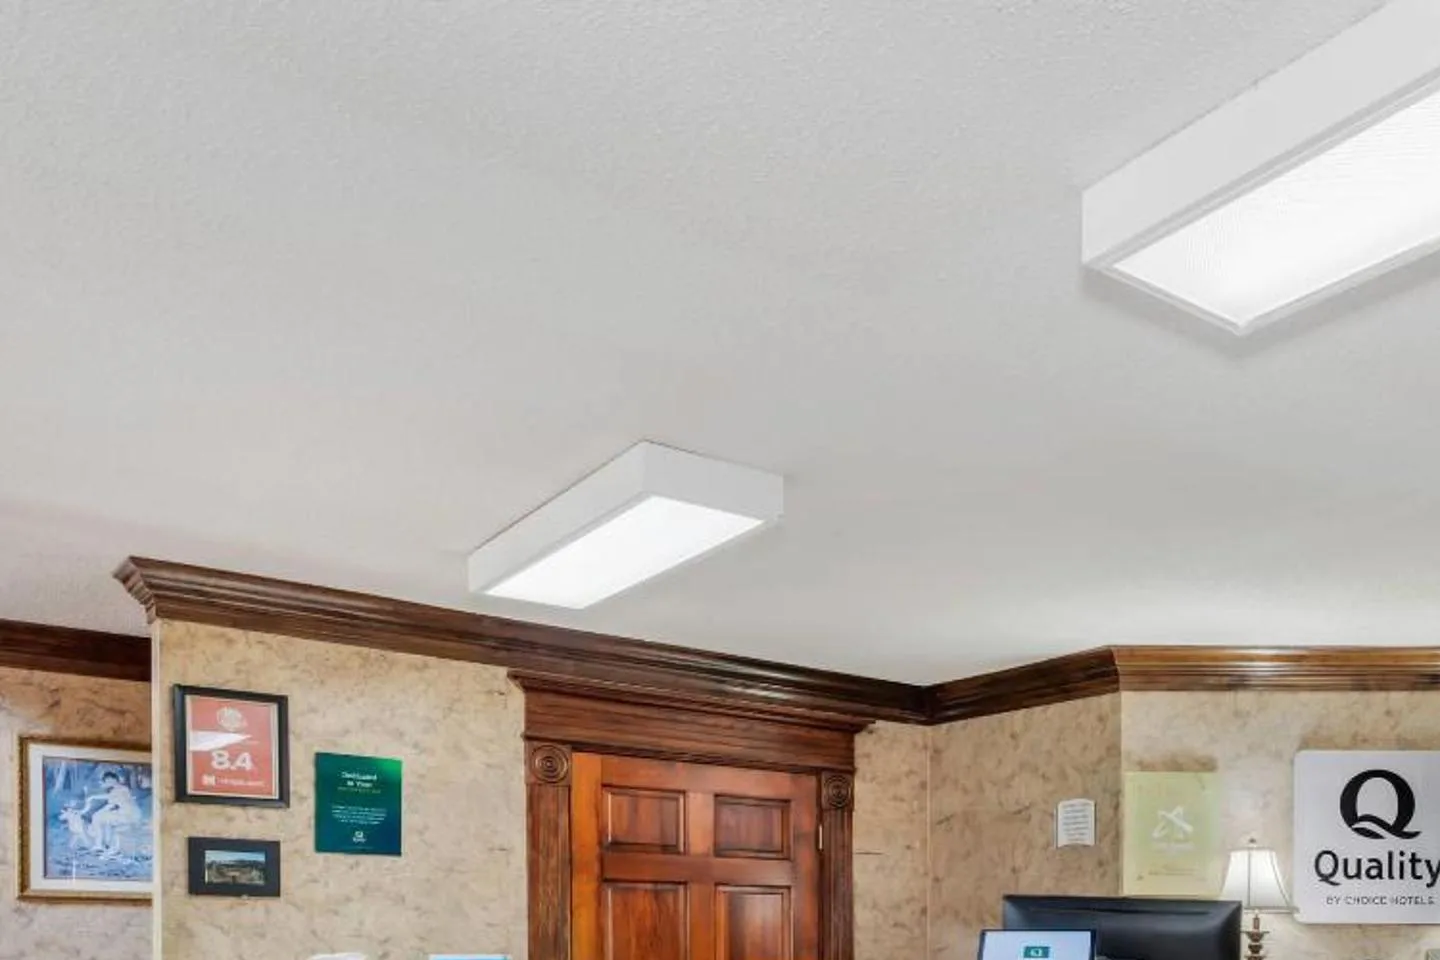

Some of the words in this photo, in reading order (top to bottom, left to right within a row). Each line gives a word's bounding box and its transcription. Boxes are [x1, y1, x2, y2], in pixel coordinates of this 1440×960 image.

[211, 749, 254, 771] 8.4
[1339, 769, 1421, 840] Q
[1326, 896, 1341, 905] BY
[1344, 896, 1388, 905] CHOICE
[1391, 896, 1436, 905] HOTELS
